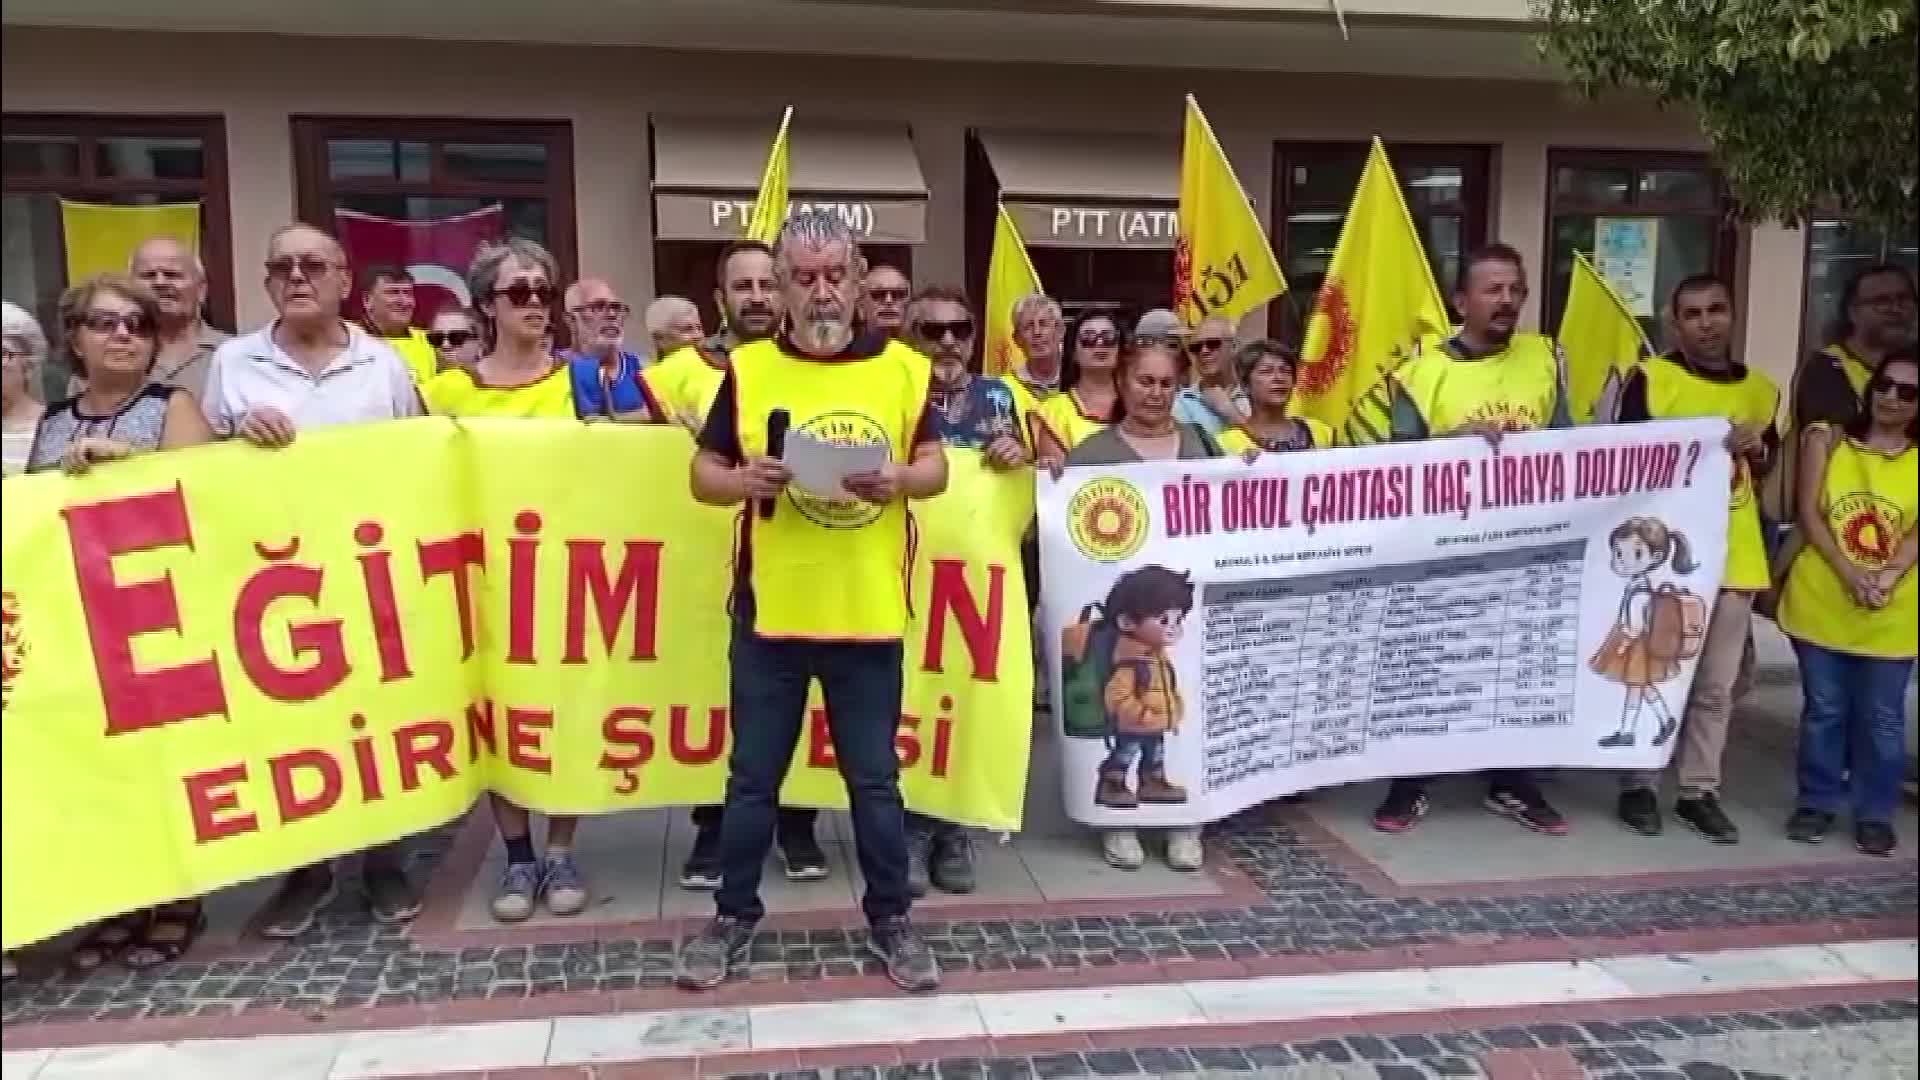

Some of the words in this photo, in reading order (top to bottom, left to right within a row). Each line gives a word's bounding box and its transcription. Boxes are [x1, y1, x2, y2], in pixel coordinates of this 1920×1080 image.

[711, 201, 758, 227] PT
[1053, 208, 1110, 235] PTT
[1162, 474, 1213, 538] BİR
[1221, 476, 1292, 532] OKUL
[1301, 465, 1413, 536] ÇANTASI
[1422, 460, 1471, 521] KAÇ
[1480, 451, 1566, 509] LİRAYA
[1574, 441, 1681, 500] DOLUYOR
[60, 478, 665, 737] EĞİTİM
[182, 699, 553, 844] EDİRNE
